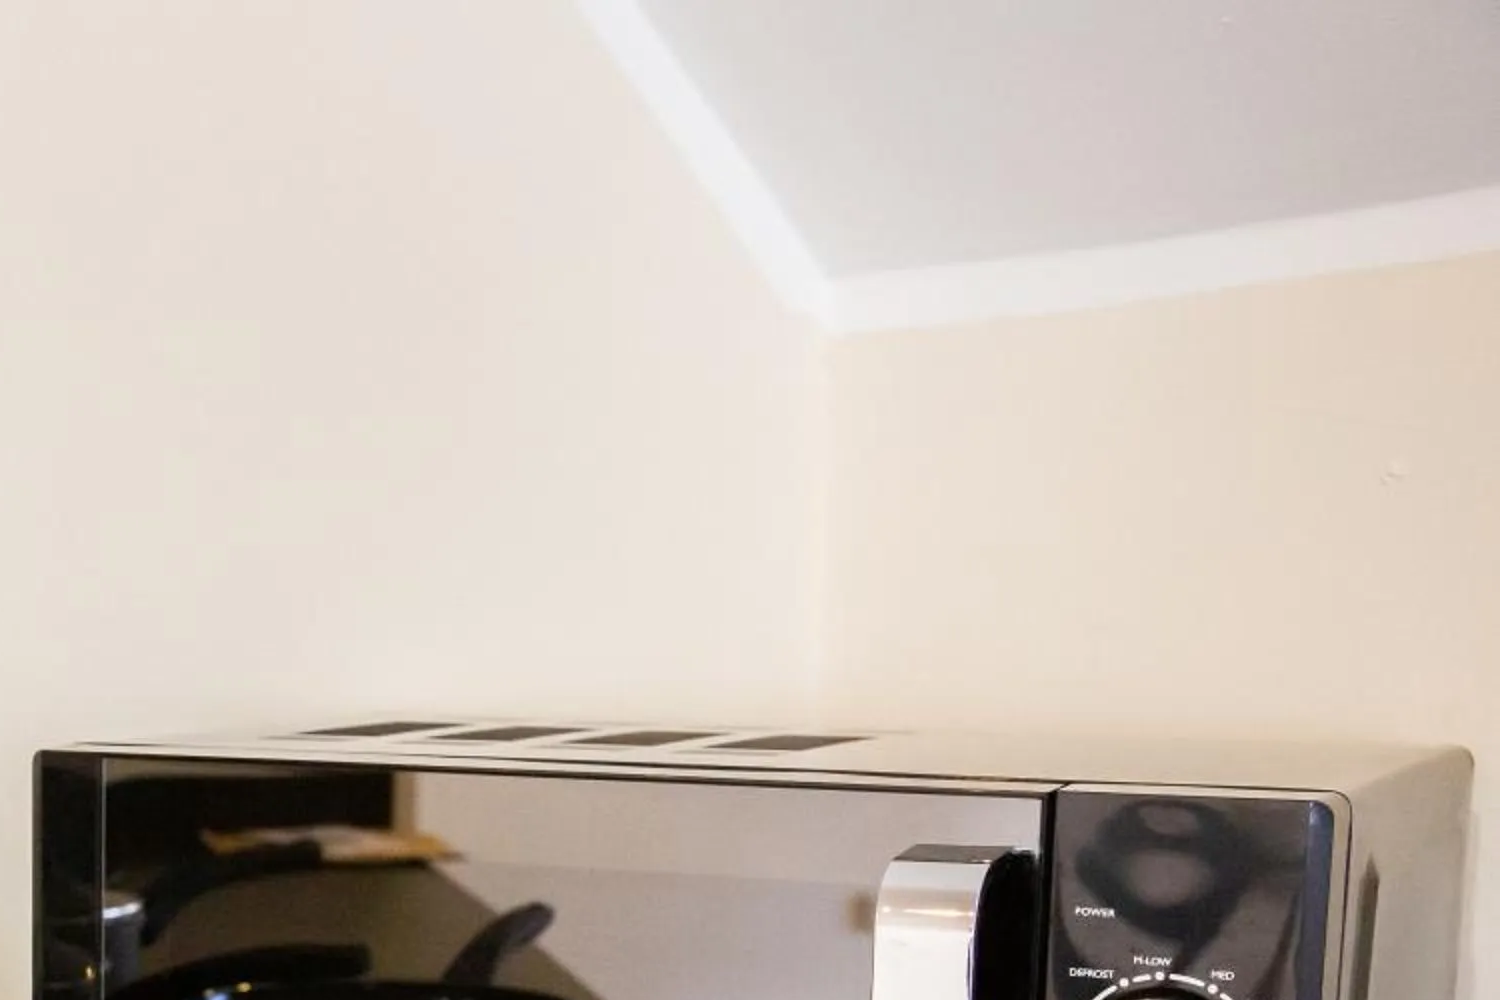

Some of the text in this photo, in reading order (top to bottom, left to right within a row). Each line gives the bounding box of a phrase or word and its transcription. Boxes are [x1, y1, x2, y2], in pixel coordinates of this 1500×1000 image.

[1074, 906, 1115, 918] POWER
[1133, 955, 1173, 966] M-LOW
[1211, 970, 1235, 981] MED
